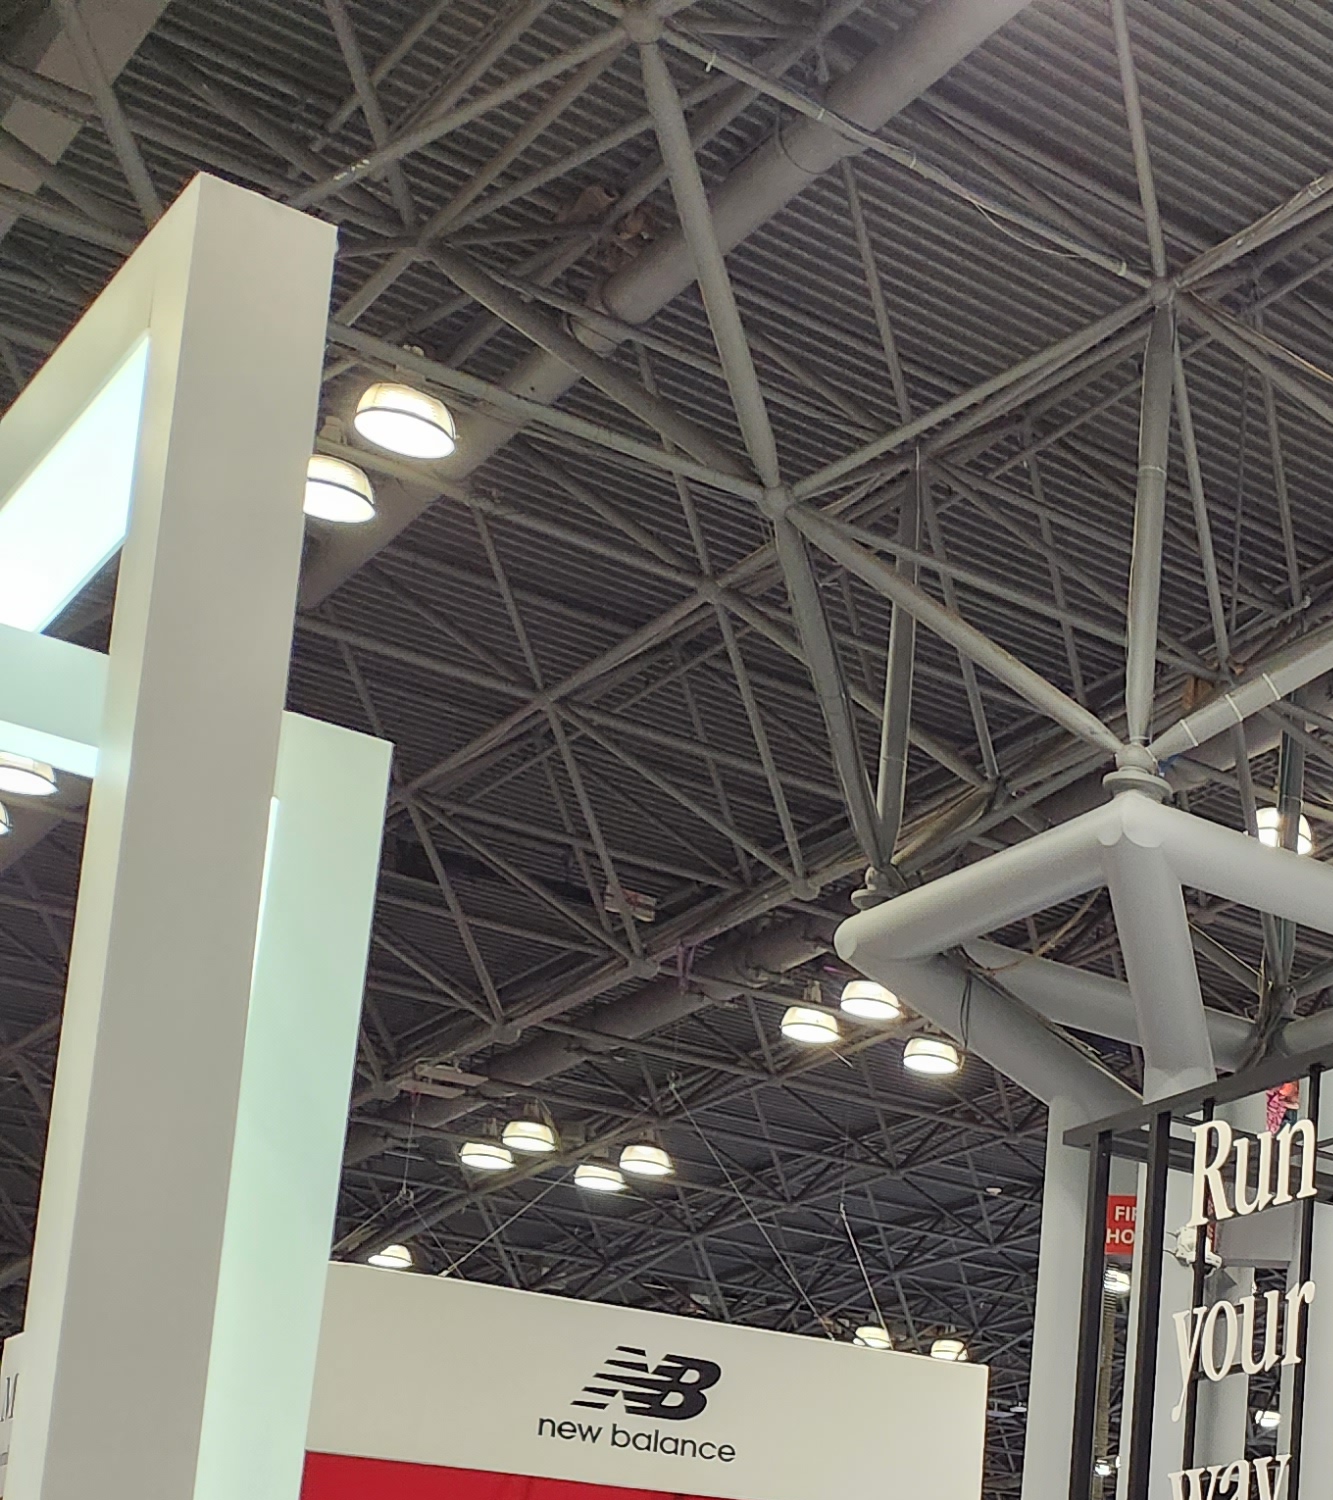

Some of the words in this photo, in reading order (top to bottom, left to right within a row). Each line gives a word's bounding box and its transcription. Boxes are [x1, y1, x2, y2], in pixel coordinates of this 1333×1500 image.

[1187, 1117, 1318, 1227] Run
[1105, 1227, 1136, 1245] HO
[569, 1345, 722, 1421] NB
[1170, 1279, 1316, 1424] your
[537, 1417, 603, 1444] new
[610, 1423, 737, 1463] balance
